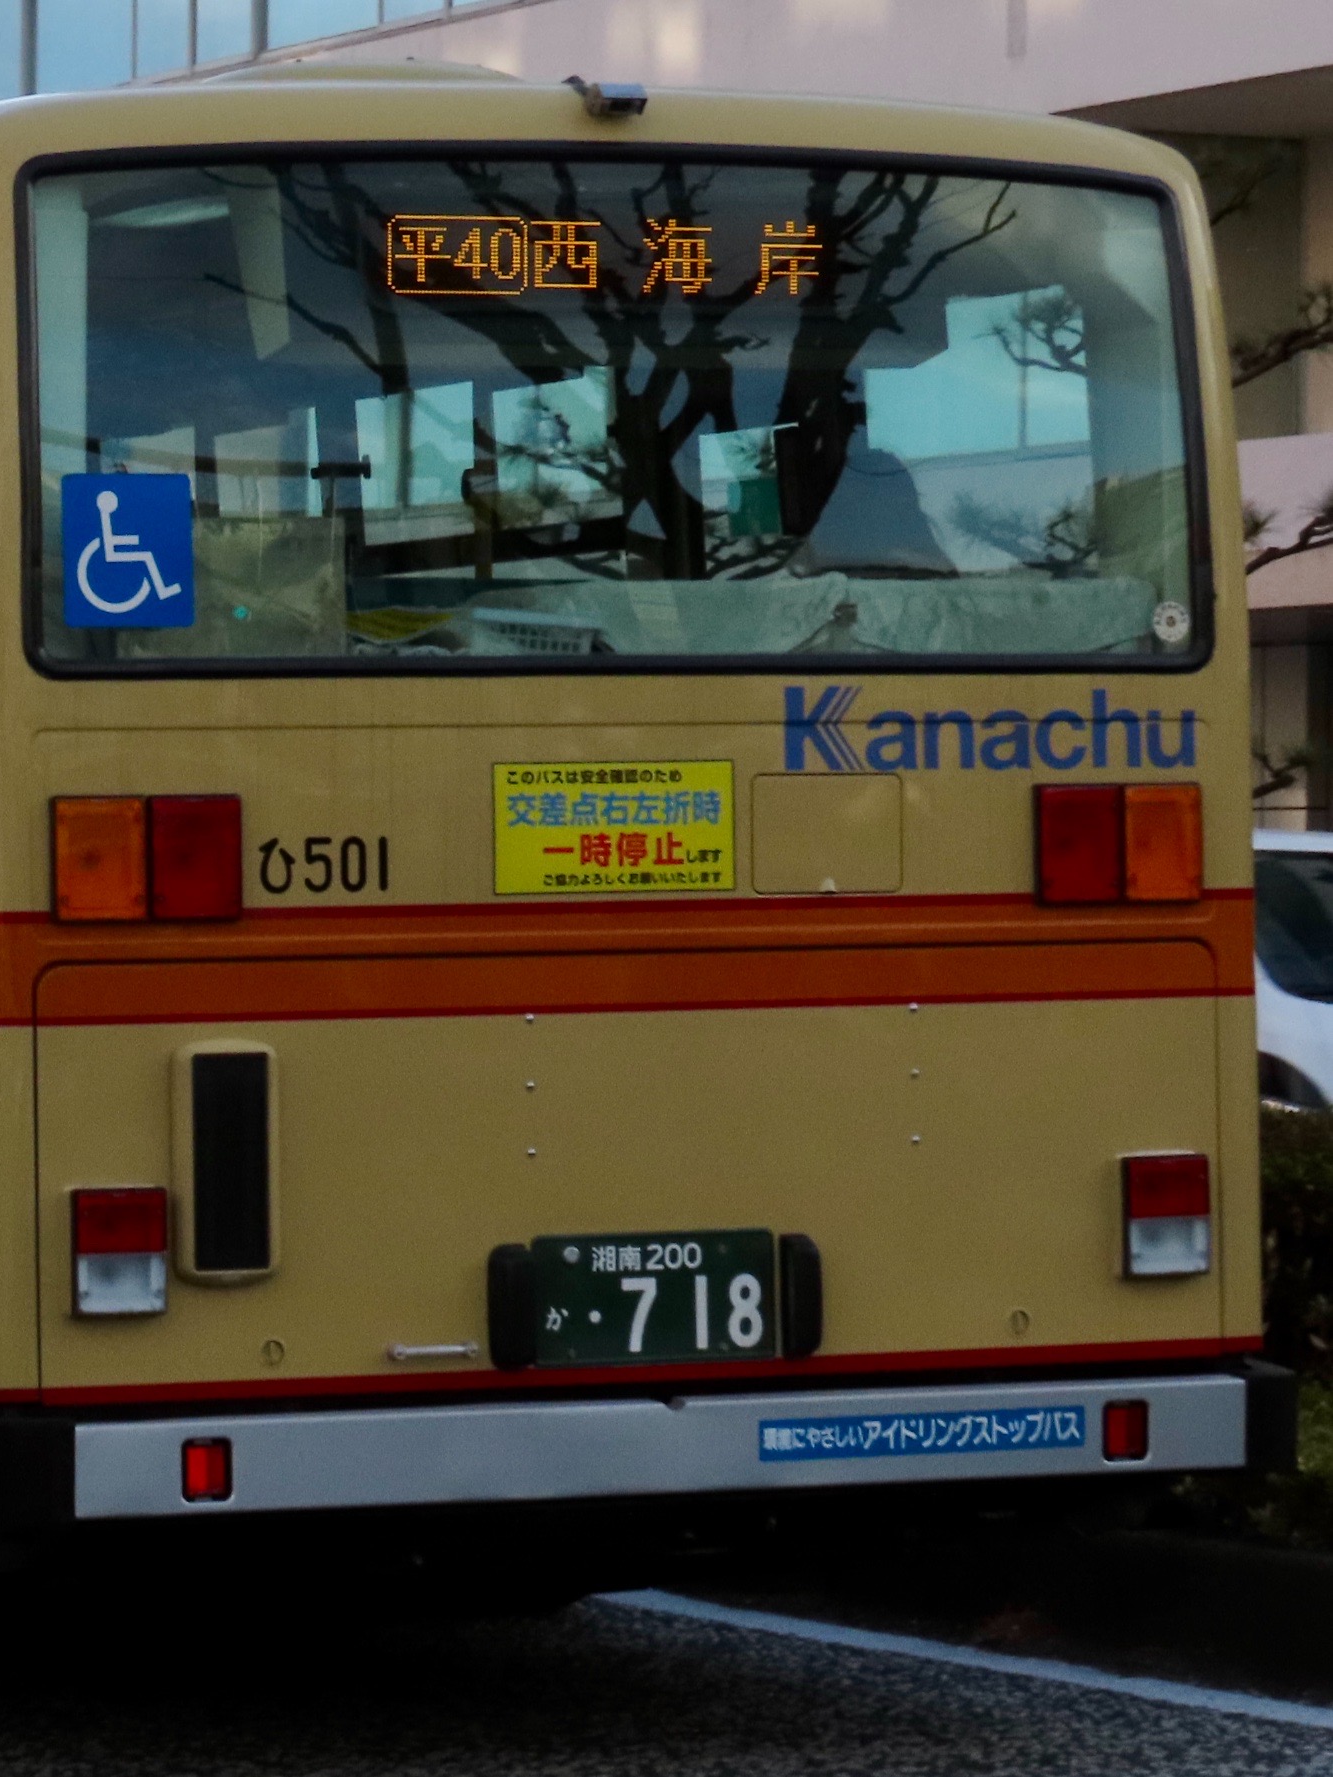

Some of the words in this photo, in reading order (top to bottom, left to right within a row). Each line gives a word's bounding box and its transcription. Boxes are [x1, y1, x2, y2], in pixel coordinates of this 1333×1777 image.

[394, 226, 520, 283] 平40
[530, 218, 823, 296] 西海岸
[783, 685, 1197, 771] Kanachu
[506, 790, 721, 827] 交差点右左折時
[542, 871, 722, 887] ご力よろしくおいいたします
[545, 1305, 570, 1331] か
[762, 1410, 1081, 1451] にやさしいアイドリングストップバス
